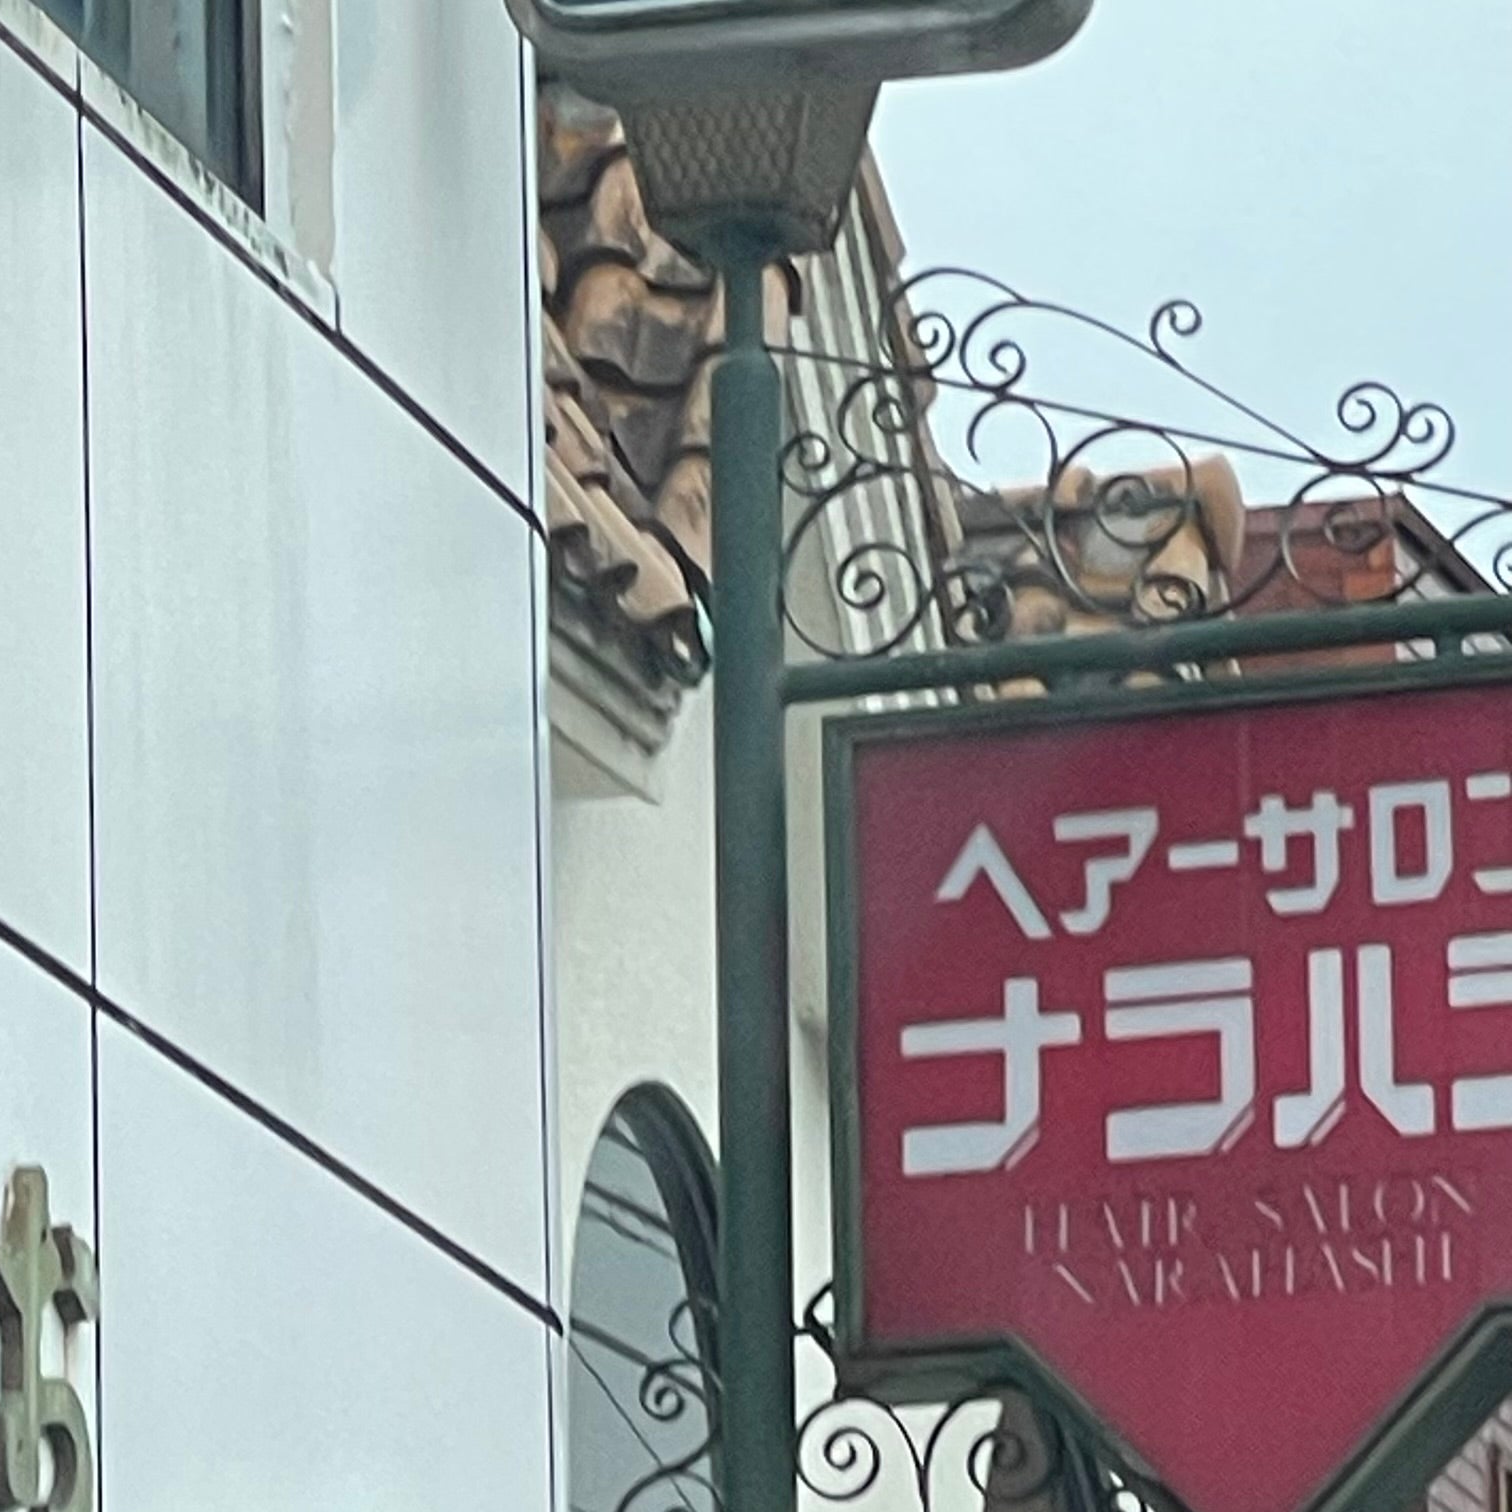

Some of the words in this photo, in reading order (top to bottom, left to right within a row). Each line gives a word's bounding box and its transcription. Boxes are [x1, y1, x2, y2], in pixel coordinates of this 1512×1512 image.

[1023, 1195, 1198, 1256] HAIR
[1254, 1174, 1473, 1236] SALON
[1053, 1230, 1452, 1307] NARAHASHI
